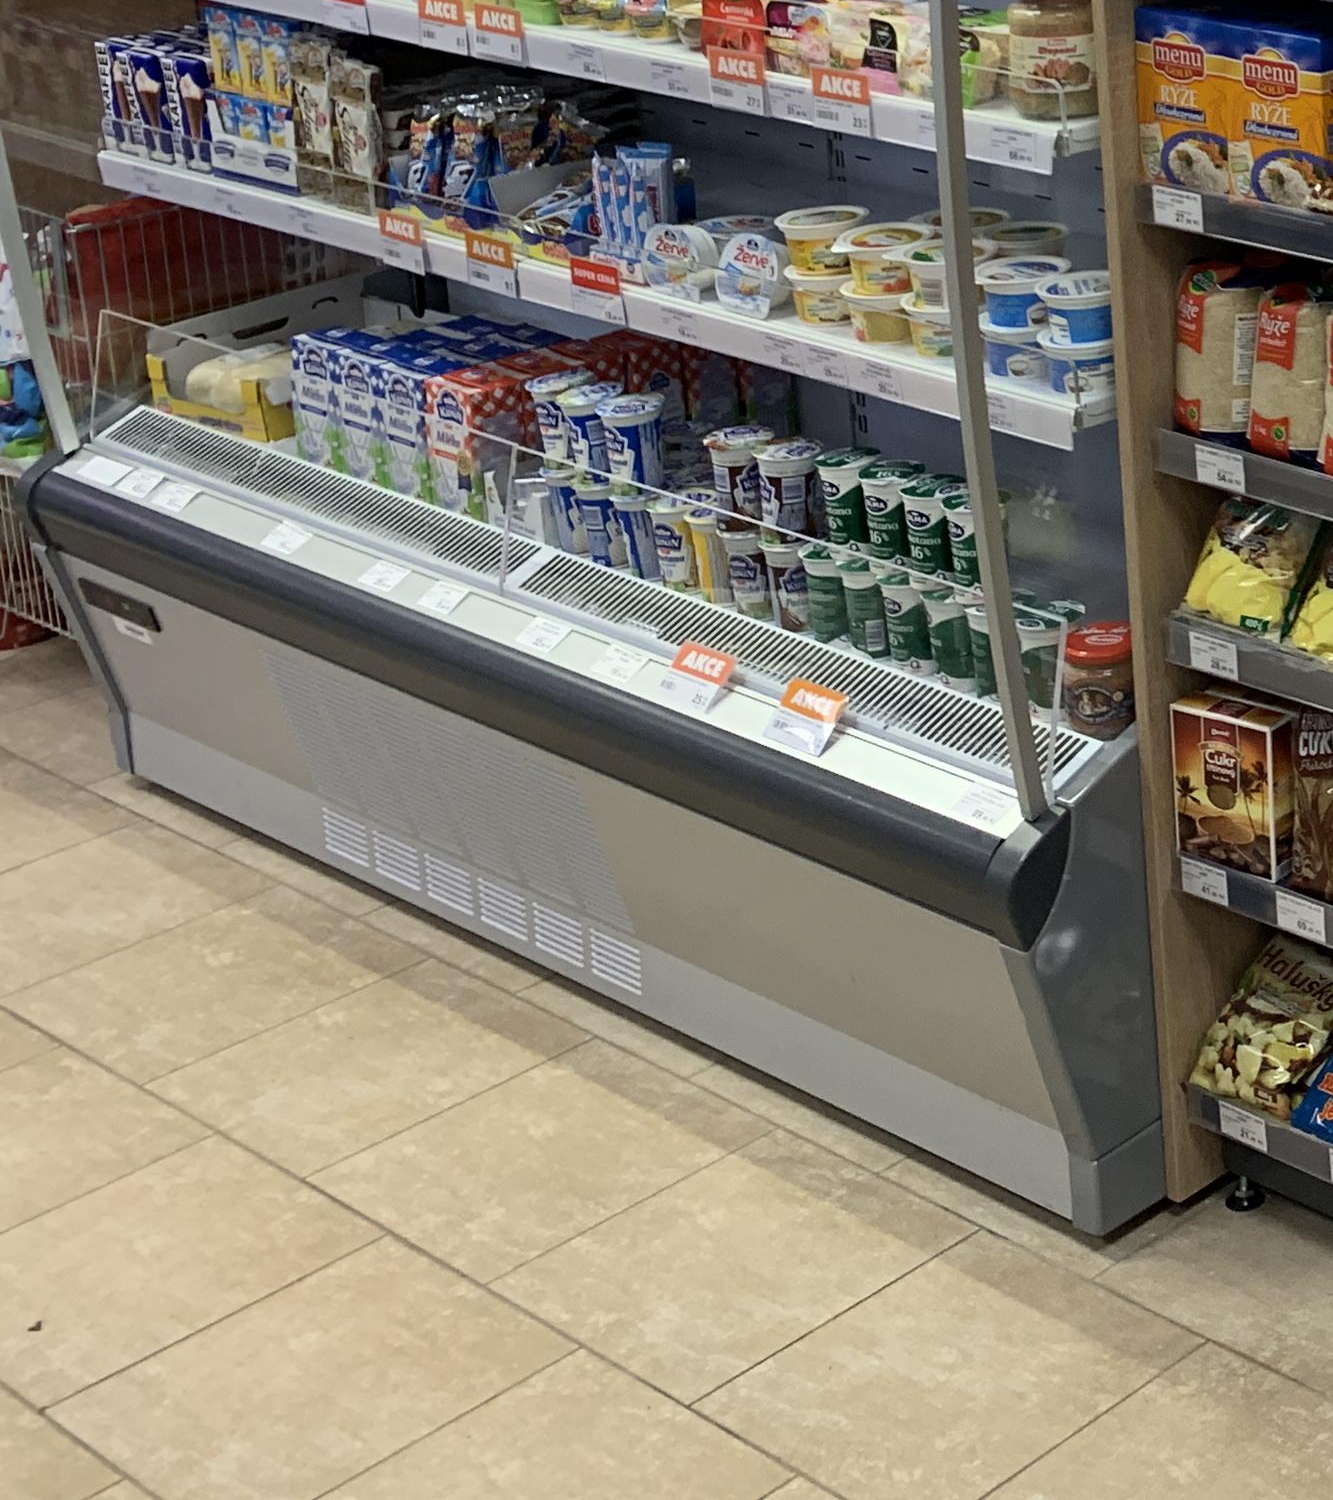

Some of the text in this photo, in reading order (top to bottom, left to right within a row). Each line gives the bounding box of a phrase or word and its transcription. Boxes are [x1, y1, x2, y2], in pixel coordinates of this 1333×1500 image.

[482, 9, 516, 32] AKCE
[716, 55, 758, 80] AKCE
[1243, 63, 1296, 86] menu
[1249, 99, 1294, 125] RÝŽE
[384, 216, 416, 240] AKCE
[681, 648, 728, 678] AKCE
